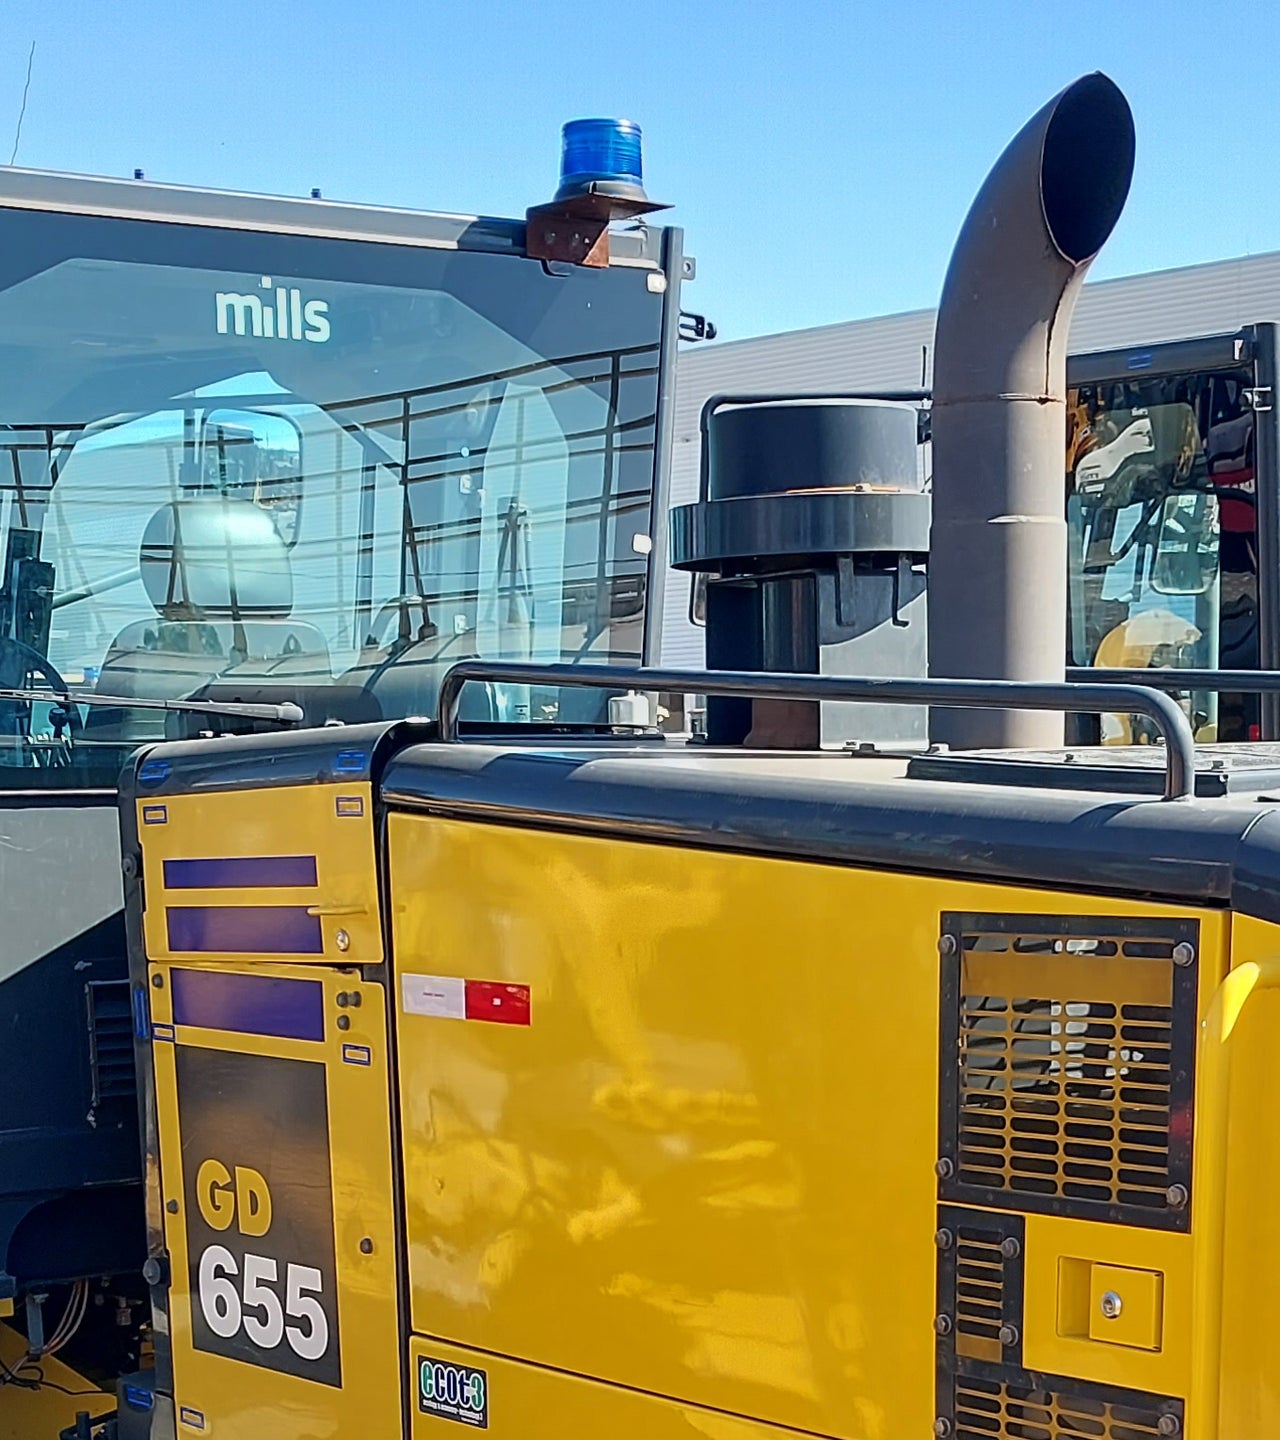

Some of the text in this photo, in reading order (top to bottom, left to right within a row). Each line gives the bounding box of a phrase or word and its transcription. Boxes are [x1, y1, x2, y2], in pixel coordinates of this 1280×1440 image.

[216, 276, 331, 343] mills
[197, 1159, 272, 1237] GD
[199, 1245, 329, 1361] 655
